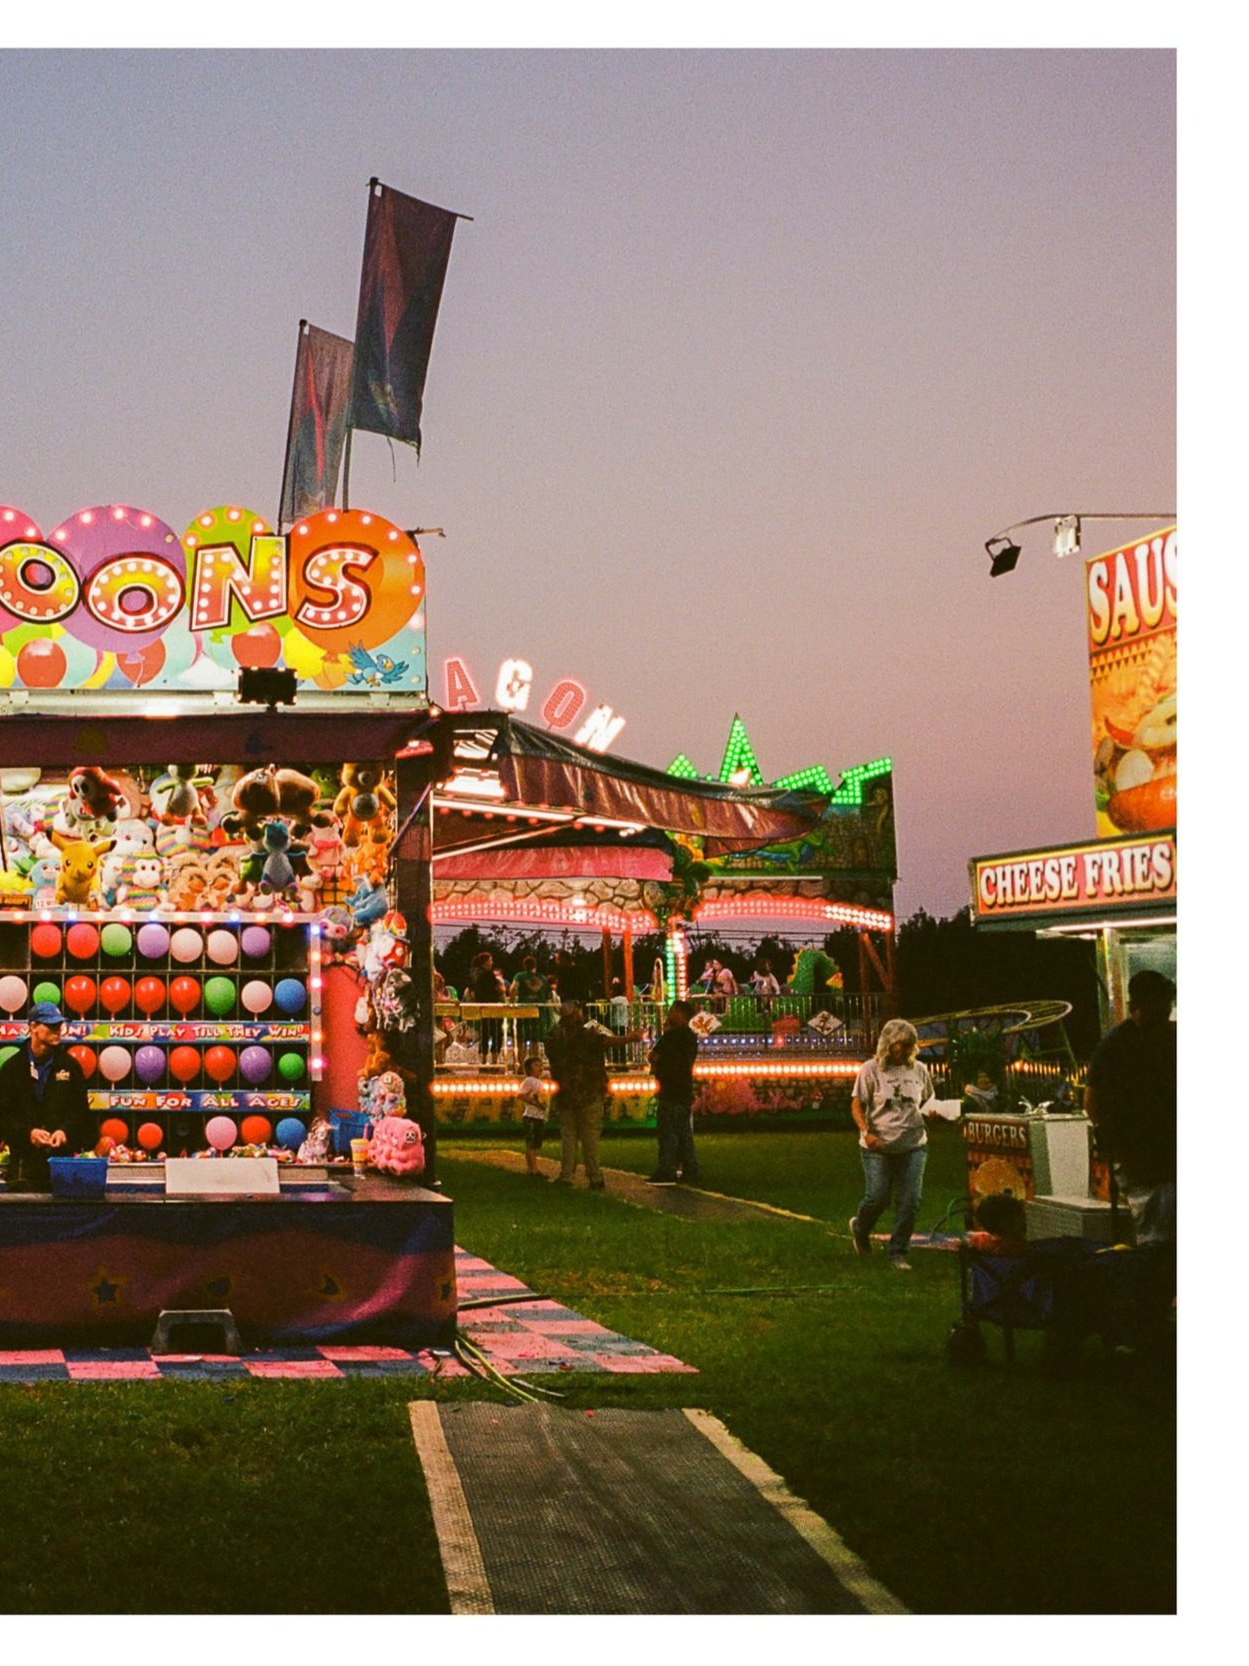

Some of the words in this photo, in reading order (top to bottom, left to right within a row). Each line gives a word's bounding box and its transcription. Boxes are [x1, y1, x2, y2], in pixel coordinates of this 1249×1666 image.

[444, 657, 627, 757] AGON
[979, 853, 1079, 908] CHEESE
[1084, 841, 1174, 897] FRIES
[109, 1026, 143, 1037] KIDS
[150, 1026, 185, 1037] PLAY
[227, 1026, 262, 1037] THEY
[109, 1095, 146, 1107] FUN
[156, 1095, 192, 1108] FOR
[202, 1095, 240, 1108] ALL
[248, 1095, 301, 1108] AGES
[967, 1120, 1028, 1150] BURGERS
